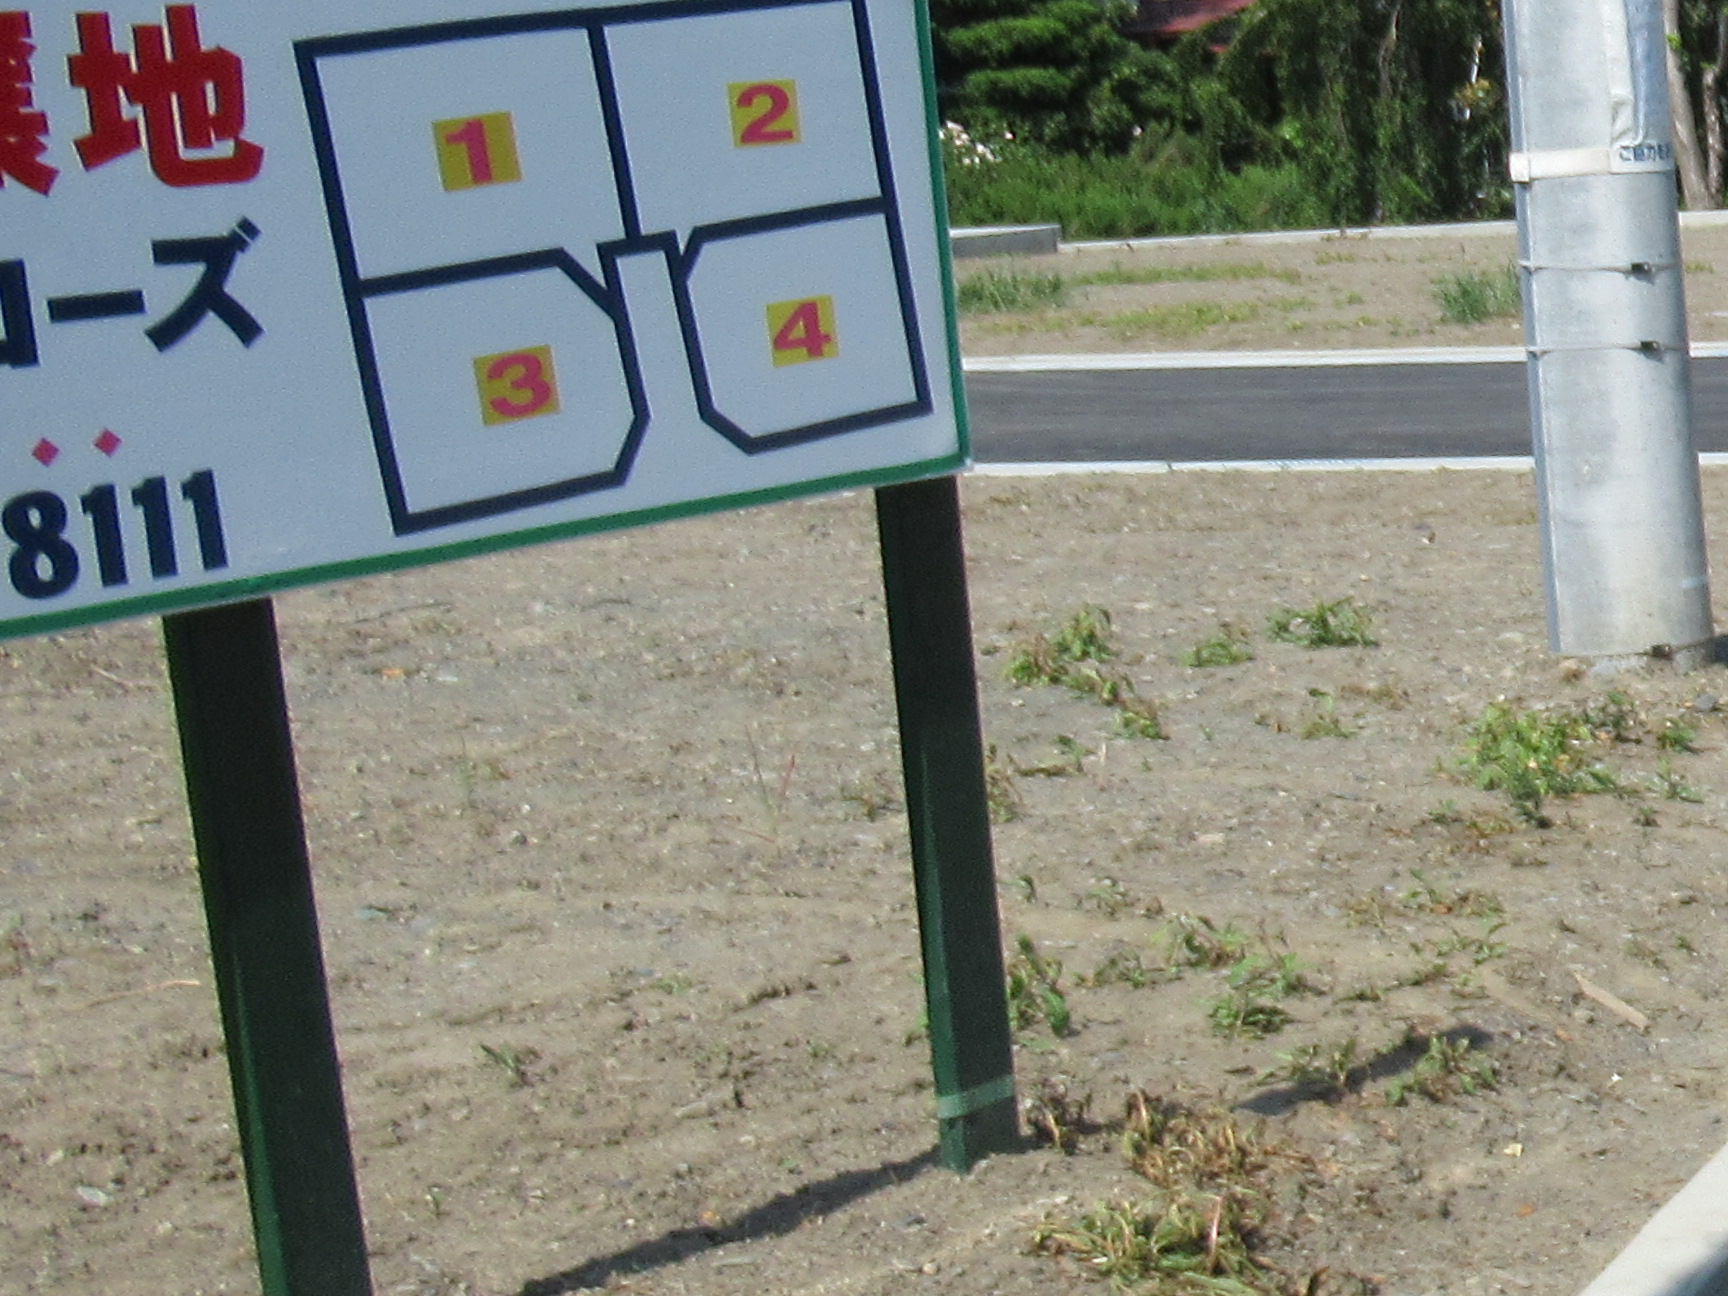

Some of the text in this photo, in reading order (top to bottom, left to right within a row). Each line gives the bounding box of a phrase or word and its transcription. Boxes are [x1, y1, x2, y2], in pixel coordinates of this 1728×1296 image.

[736, 84, 795, 144] 2
[444, 120, 496, 185] 1
[771, 300, 832, 360] 4
[485, 353, 550, 417] 3
[2, 468, 229, 600] 8111
